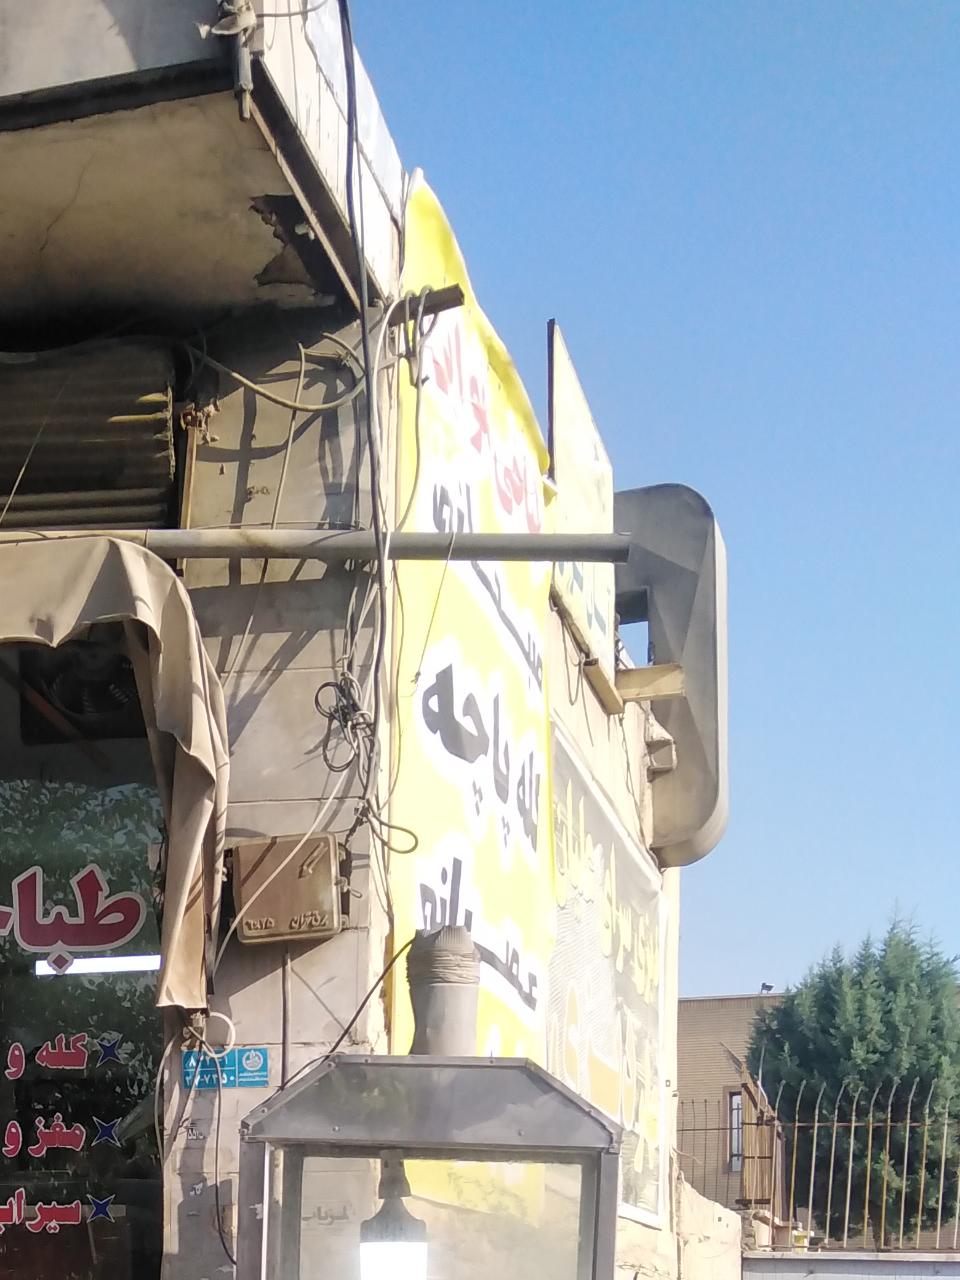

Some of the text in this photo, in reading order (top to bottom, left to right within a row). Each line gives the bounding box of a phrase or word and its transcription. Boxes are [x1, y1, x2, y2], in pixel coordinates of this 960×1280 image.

[421, 662, 511, 850] پاچه
[4, 1041, 27, 1081] و
[35, 1031, 92, 1071] کله
[1, 1119, 24, 1159] و
[27, 1111, 88, 1159] مغز
